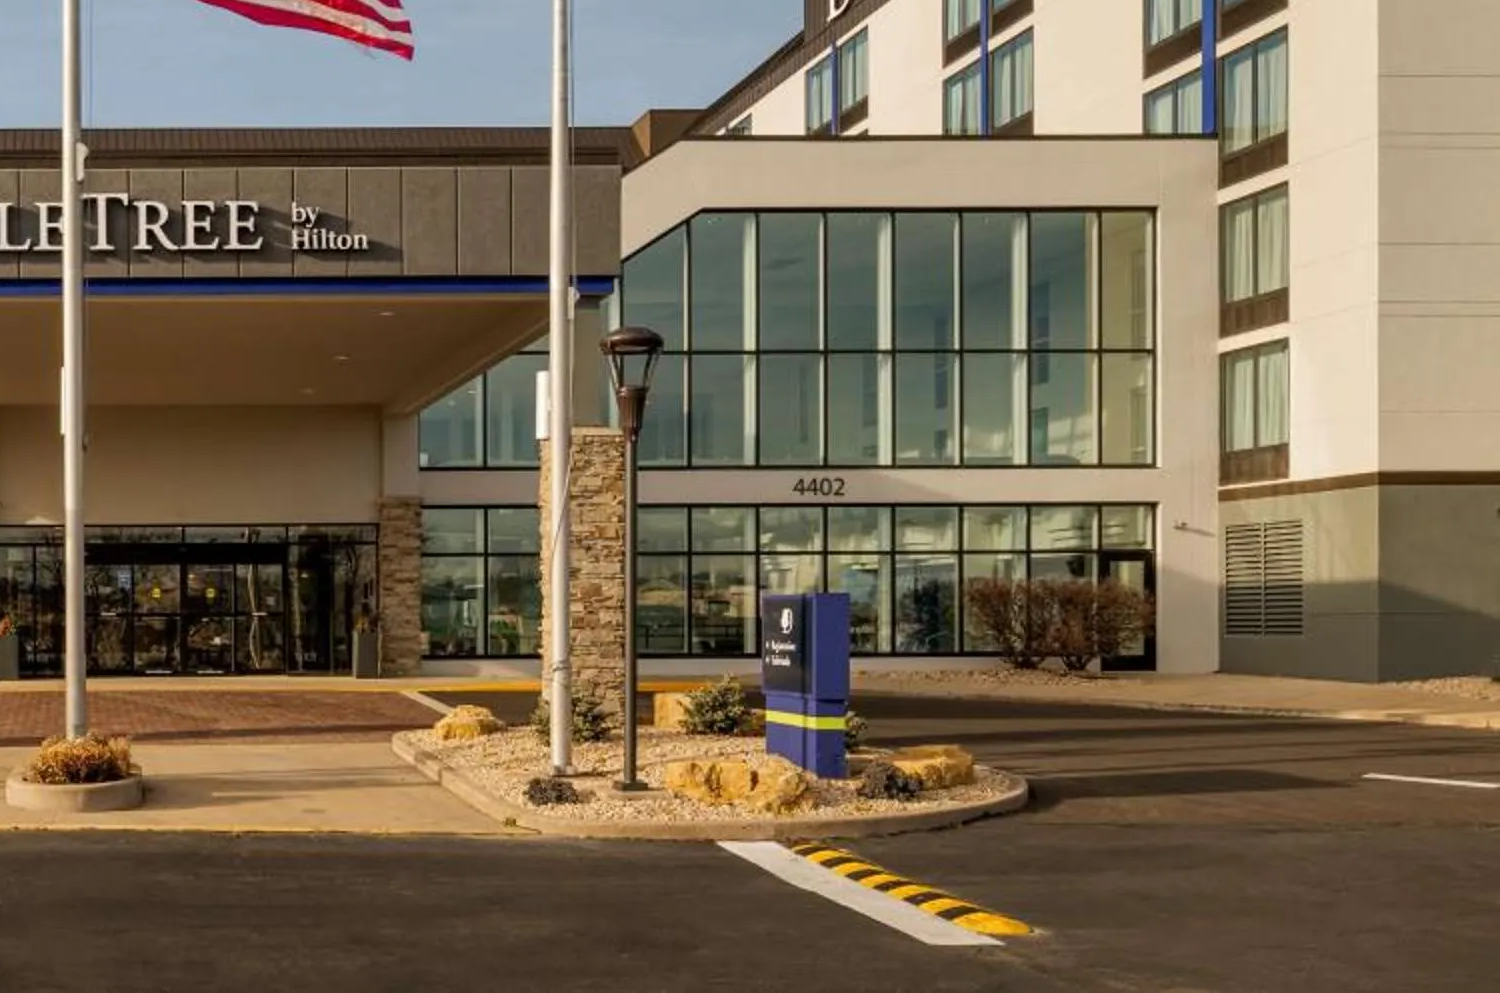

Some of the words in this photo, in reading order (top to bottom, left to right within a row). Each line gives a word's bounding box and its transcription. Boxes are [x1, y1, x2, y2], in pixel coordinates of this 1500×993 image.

[291, 201, 320, 228] by
[290, 228, 368, 251] Hilton
[791, 477, 845, 496] 4402
